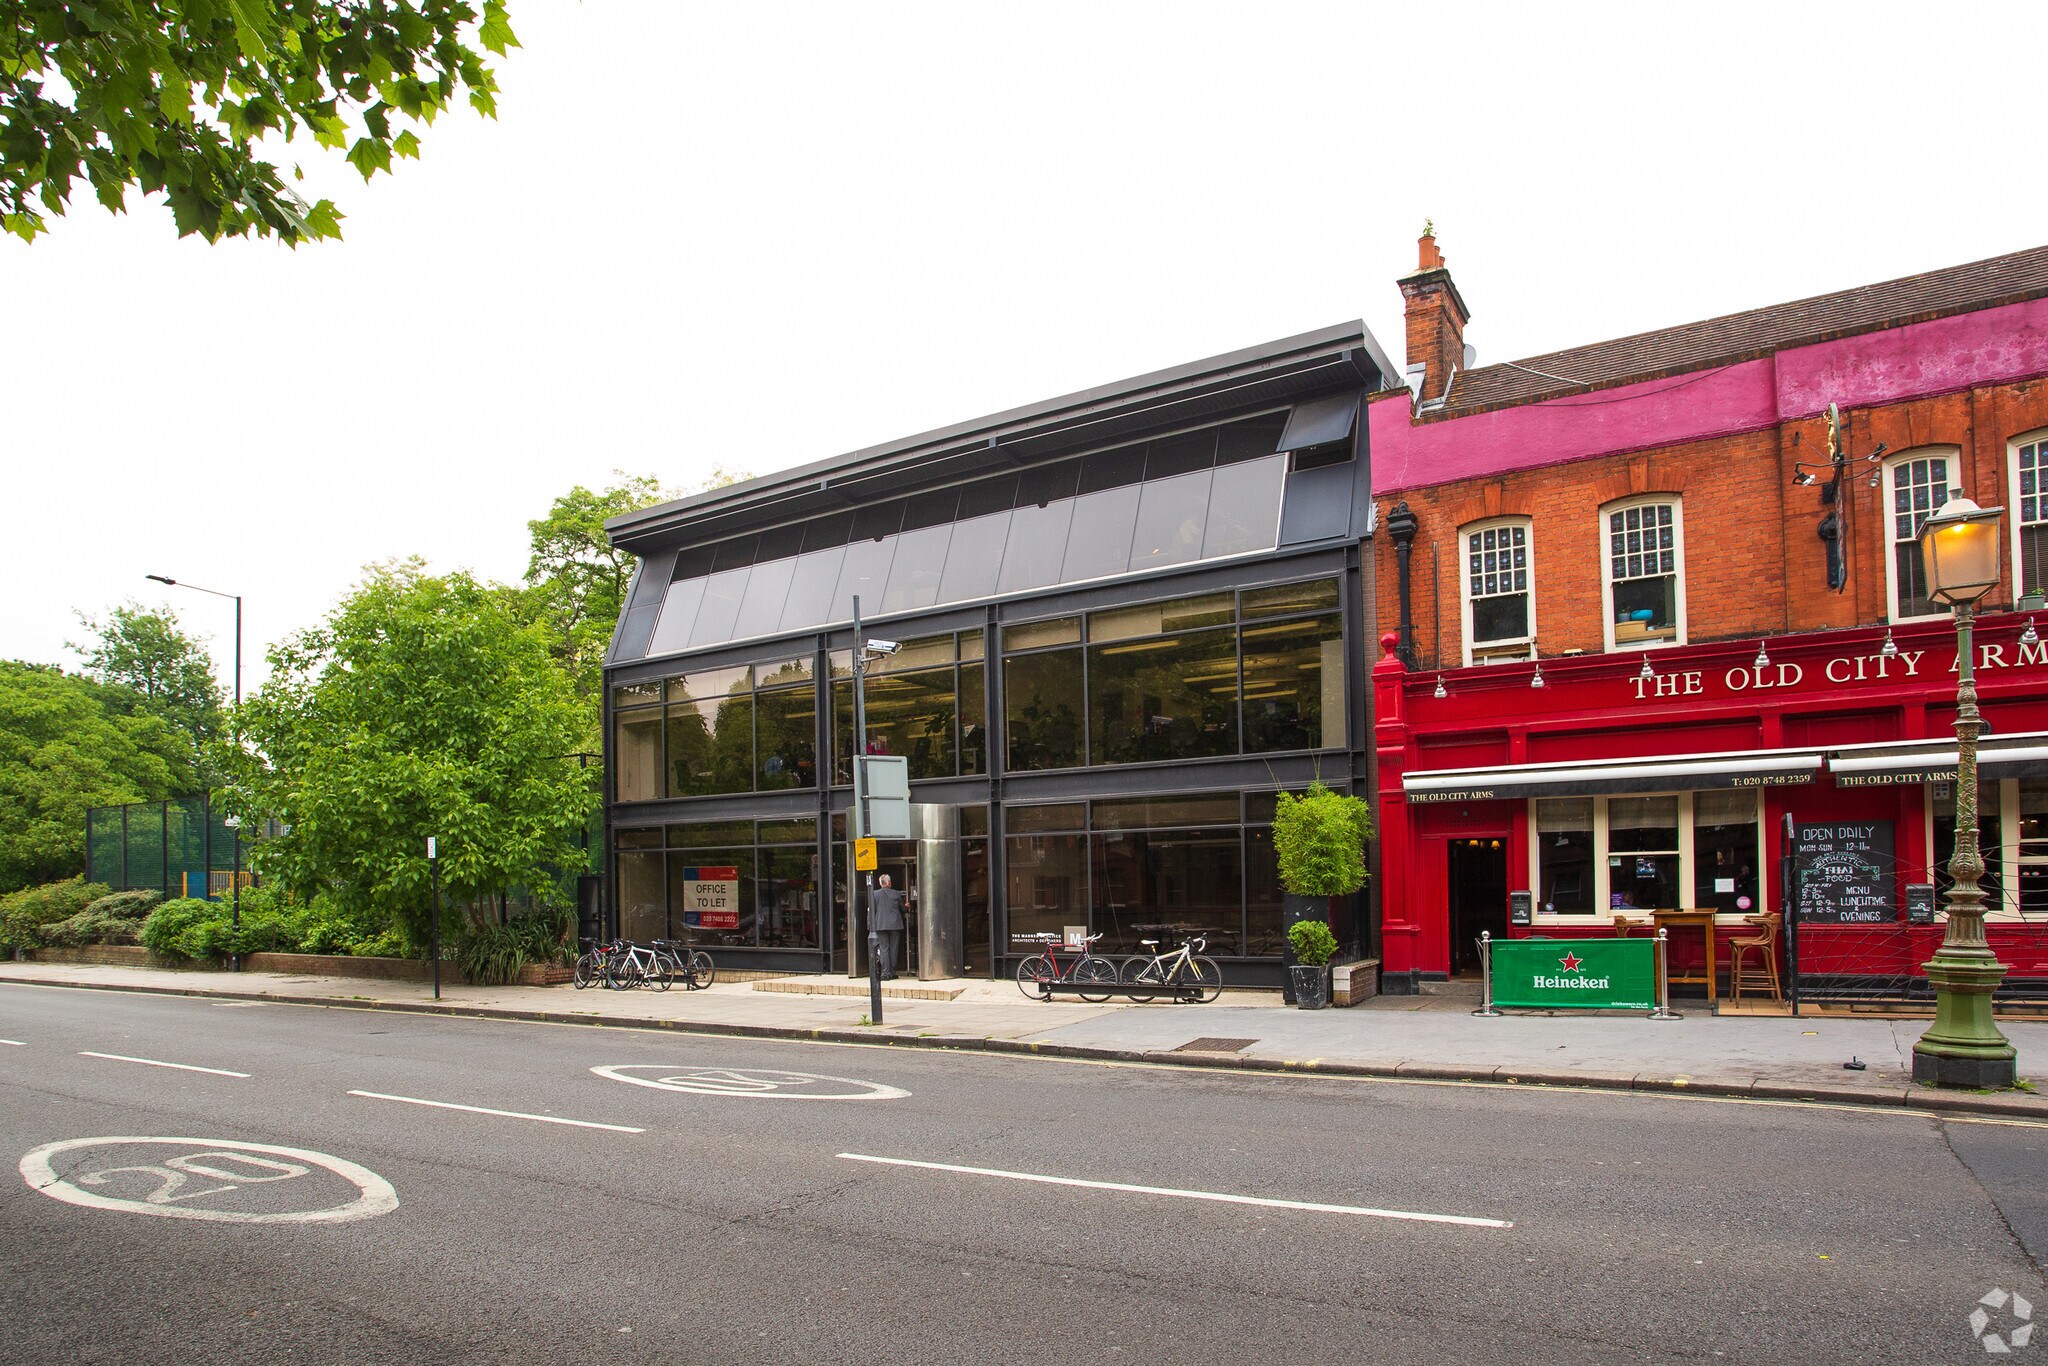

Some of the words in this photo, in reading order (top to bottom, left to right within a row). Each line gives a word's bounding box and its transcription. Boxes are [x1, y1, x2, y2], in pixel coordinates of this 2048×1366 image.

[1629, 671, 1704, 699] THE
[1725, 663, 1803, 691] OLD
[1825, 651, 1925, 683] CITY
[1732, 777, 1742, 786] T:
[1743, 777, 1761, 786] 020
[1762, 775, 1785, 785] 8748
[1787, 774, 1811, 784] 2359
[1842, 776, 1866, 786] THE
[1867, 775, 1893, 785] OLD
[1895, 773, 1922, 783] CITY
[1925, 771, 1958, 782] ARMS
[1410, 794, 1428, 802] THE
[1429, 793, 1448, 801] OLD
[1448, 791, 1469, 800] CITY
[1470, 790, 1494, 799] ARMS
[1803, 828, 1833, 841] OPEN
[1838, 826, 1875, 839] DAILY
[1816, 856, 1863, 868] AUTHENTIC
[1823, 866, 1854, 874] THAI
[696, 884, 726, 893] OFFICE
[1845, 886, 1870, 895] MENU
[697, 898, 708, 907] TO
[711, 898, 726, 907] LET
[1840, 896, 1886, 906] LUNCHTIME
[1840, 911, 1881, 922] EVENINGS
[1069, 933, 1081, 945] M
[1533, 975, 1609, 989] Heineken
[79, 1152, 310, 1203] 20
